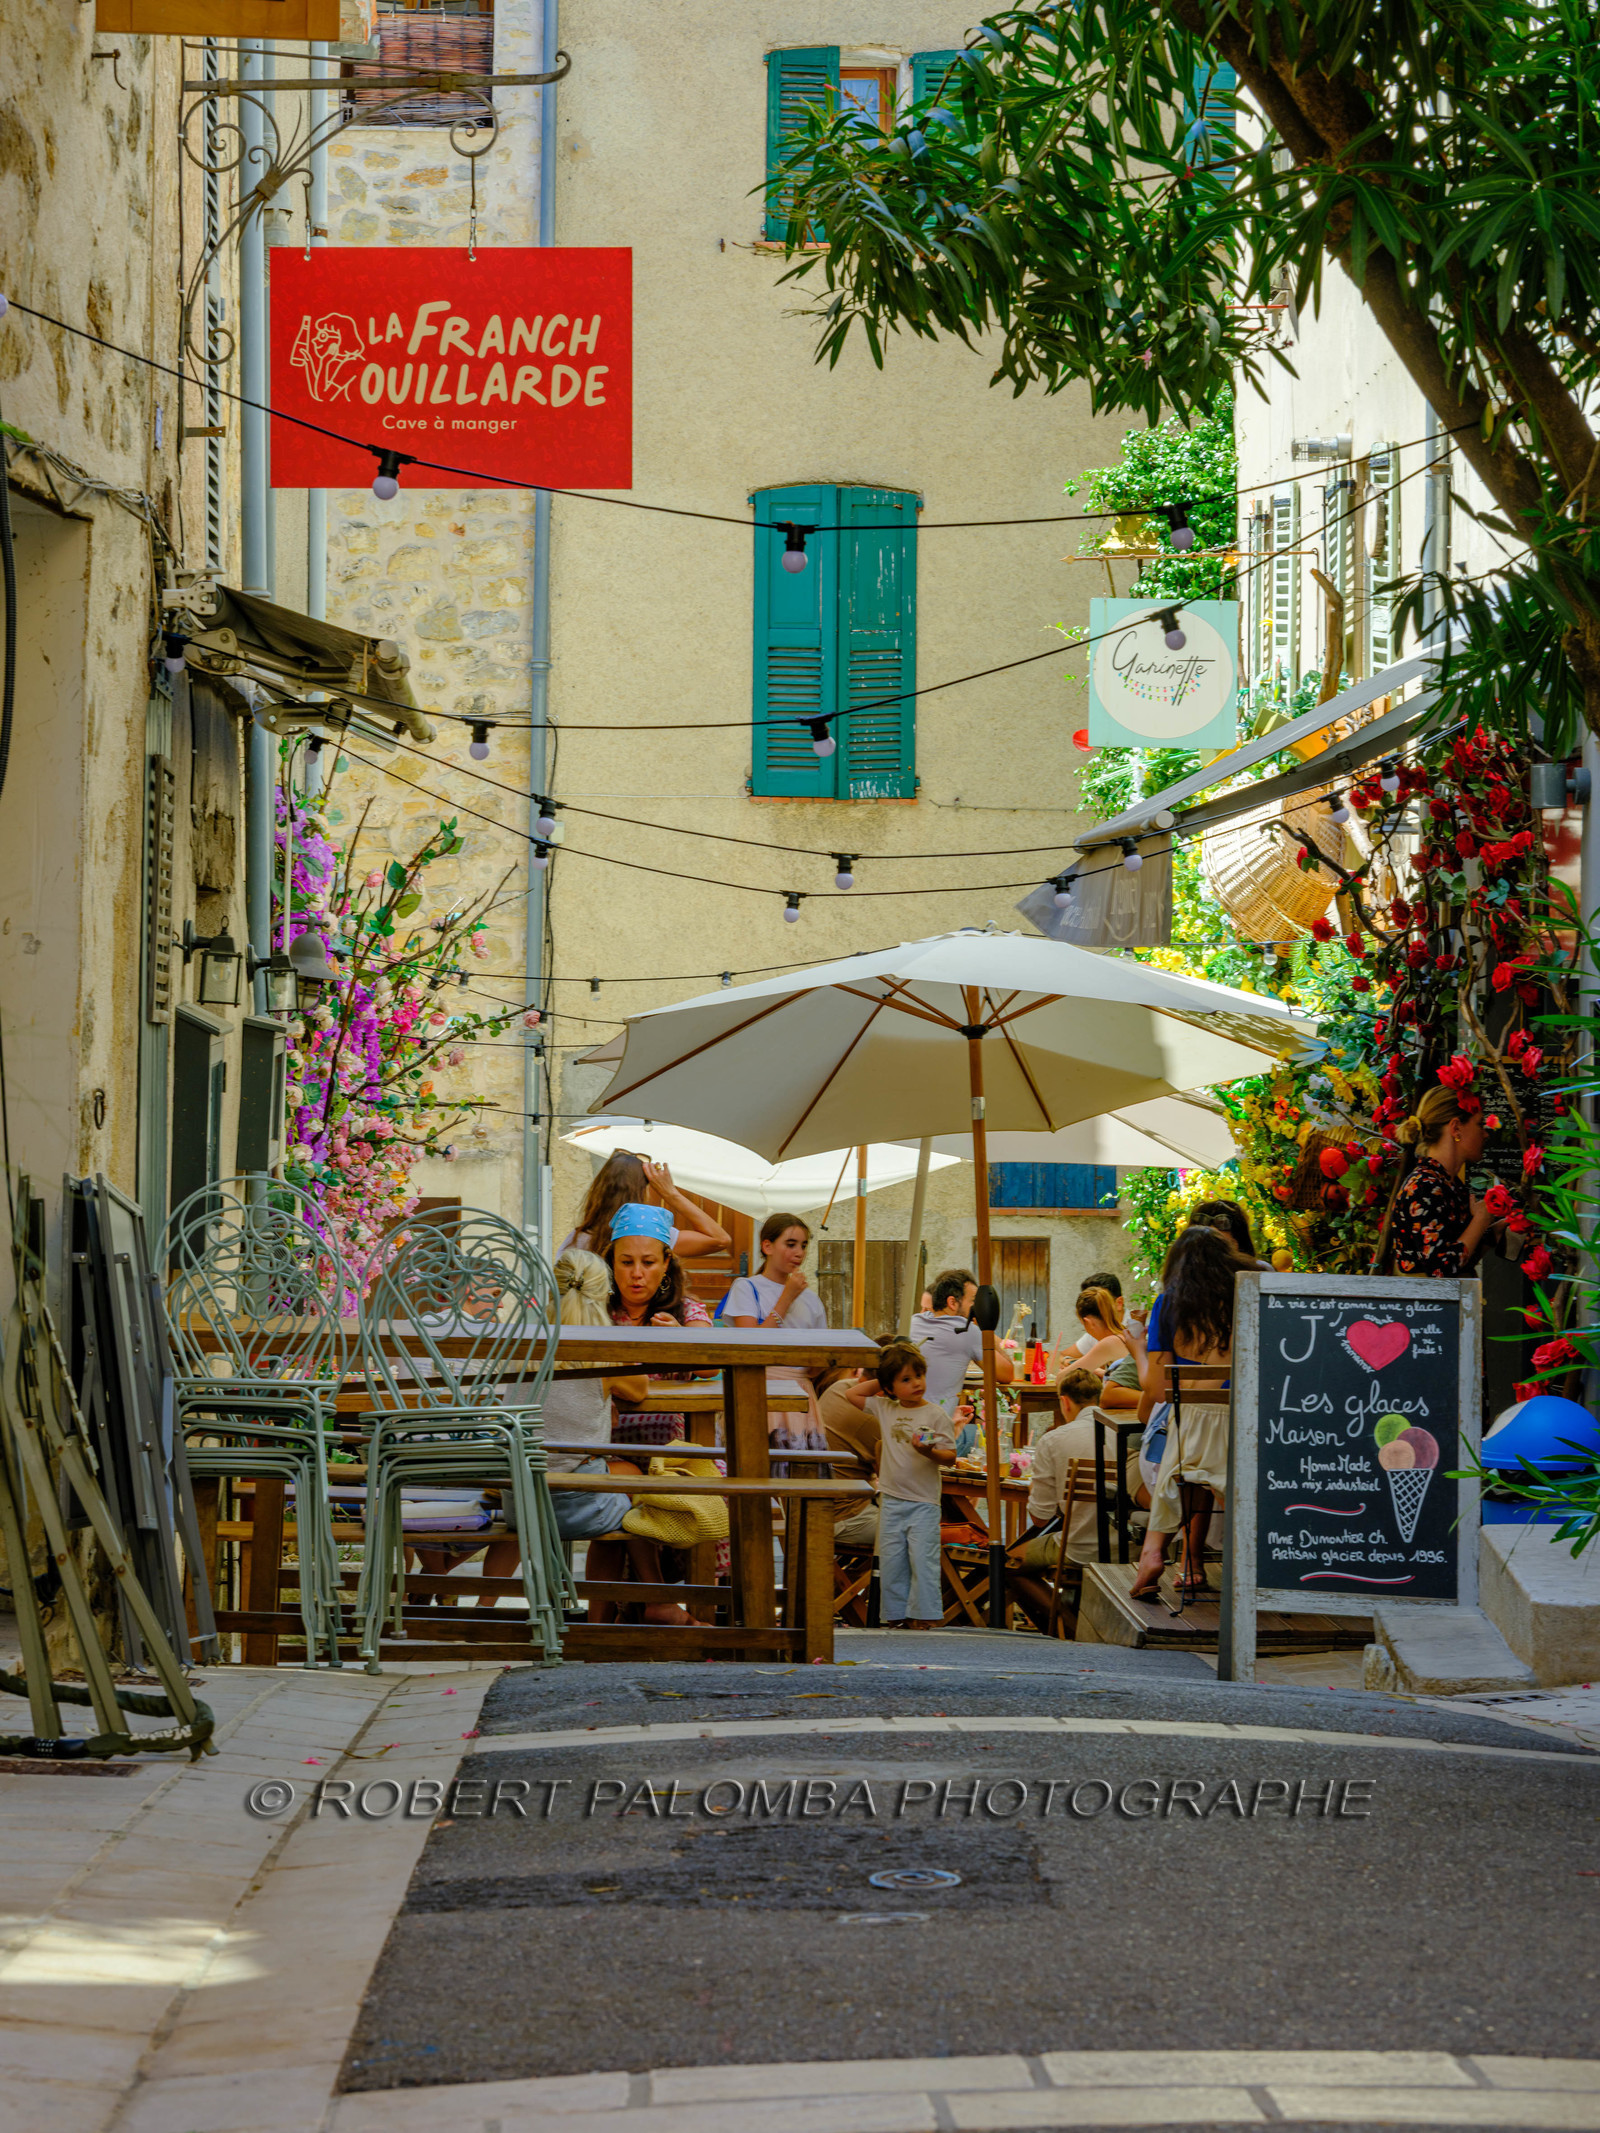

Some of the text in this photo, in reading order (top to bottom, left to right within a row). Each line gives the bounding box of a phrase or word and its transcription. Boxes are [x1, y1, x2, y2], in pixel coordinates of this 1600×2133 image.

[368, 300, 601, 359] LA FRANCH
[360, 361, 609, 407] OUILLARDE
[382, 414, 517, 435] Cave à manger
[1113, 630, 1216, 706] Garinette
[1267, 1294, 1443, 1317] la vie c'est comme une glace
[1280, 1375, 1430, 1438] Les glaces
[1265, 1417, 1346, 1447] Maison
[1267, 1470, 1381, 1494] Sans mix industriel
[1368, 1548, 1406, 1564] depuis
